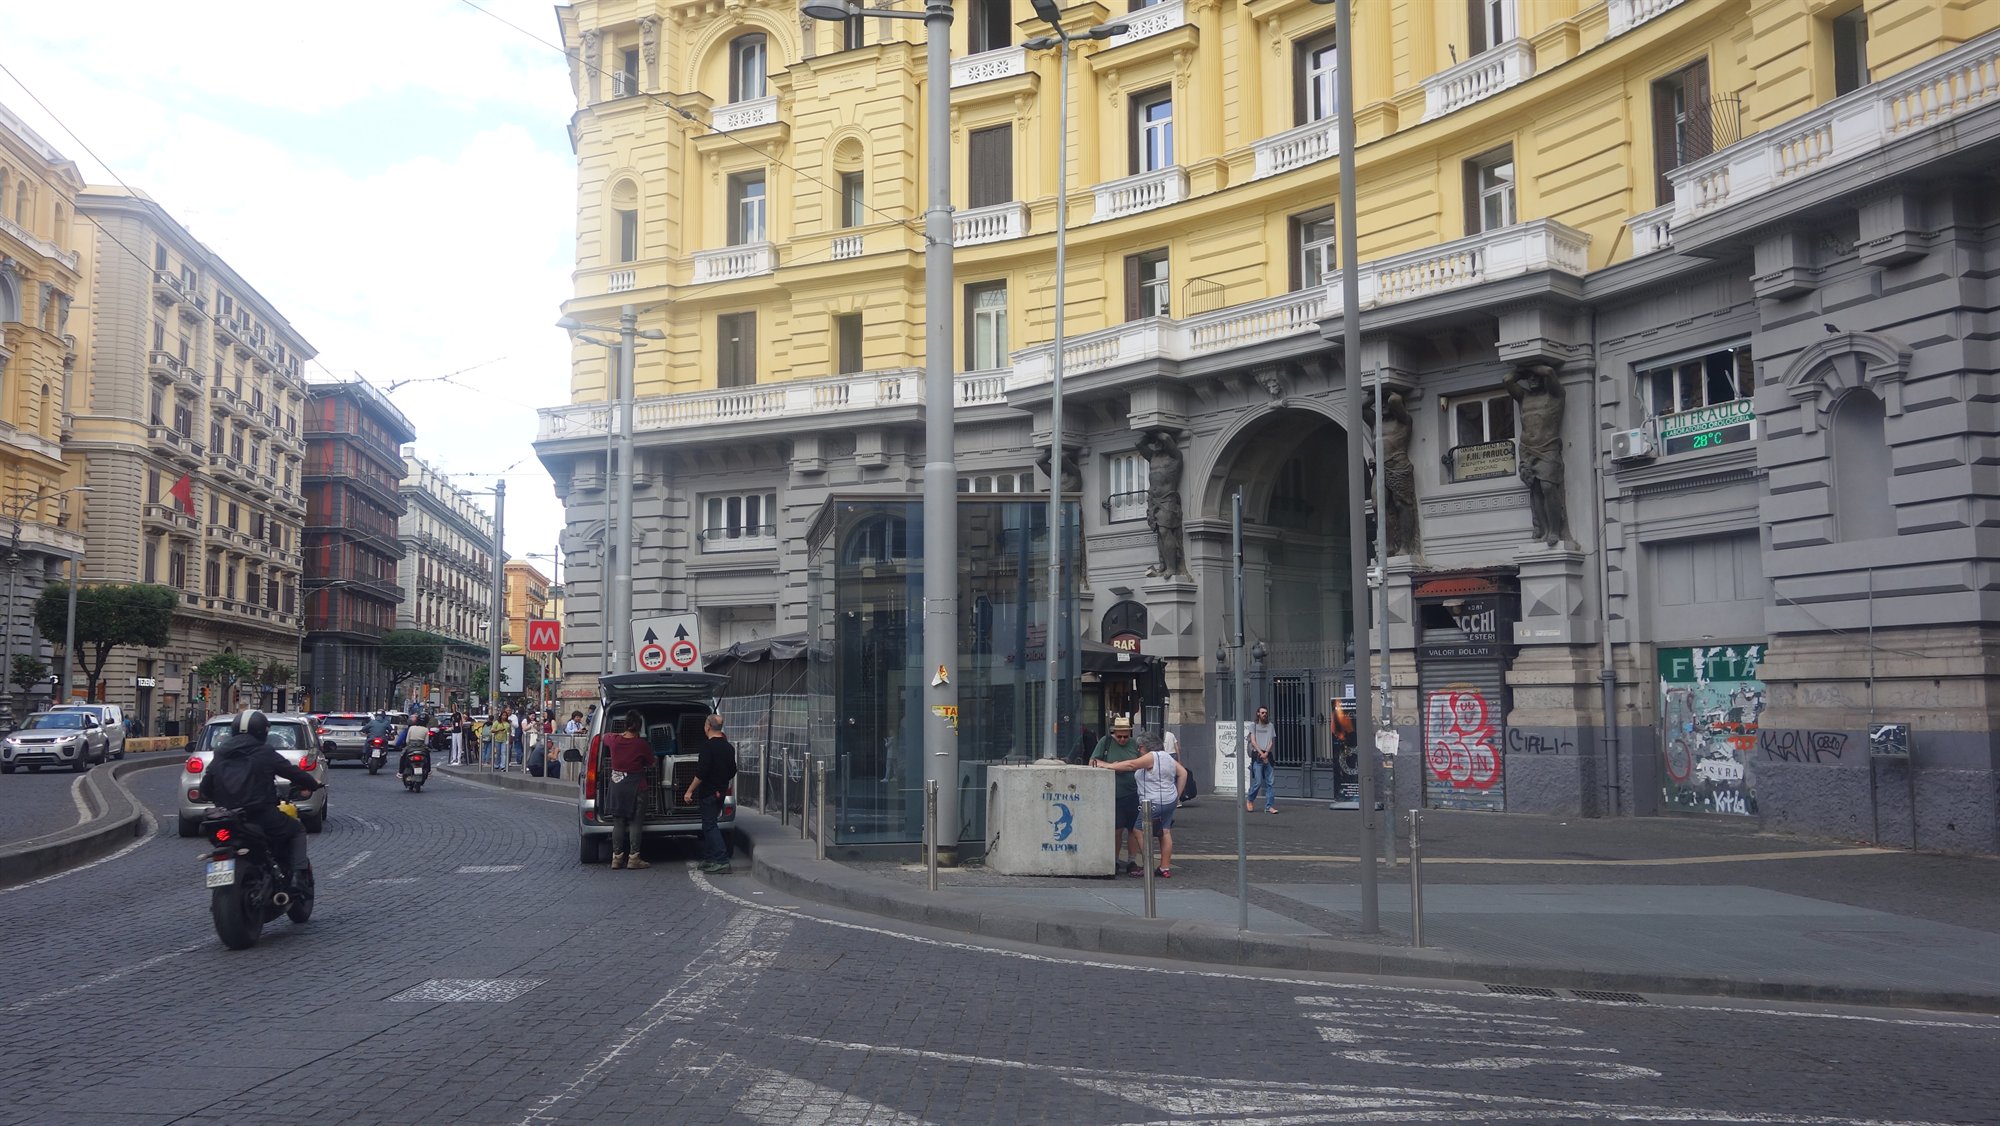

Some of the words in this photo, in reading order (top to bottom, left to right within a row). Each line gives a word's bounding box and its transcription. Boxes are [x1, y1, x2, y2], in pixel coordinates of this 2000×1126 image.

[1691, 399, 1752, 425] FRAULO
[1666, 423, 1707, 437] LABORATORIO
[1708, 415, 1750, 428] OROLOGERIA
[1693, 431, 1721, 448] 28°C
[532, 627, 557, 645] M
[1113, 639, 1136, 650] BAR
[1223, 761, 1234, 770] 50
[1042, 792, 1080, 801] ULTRAS
